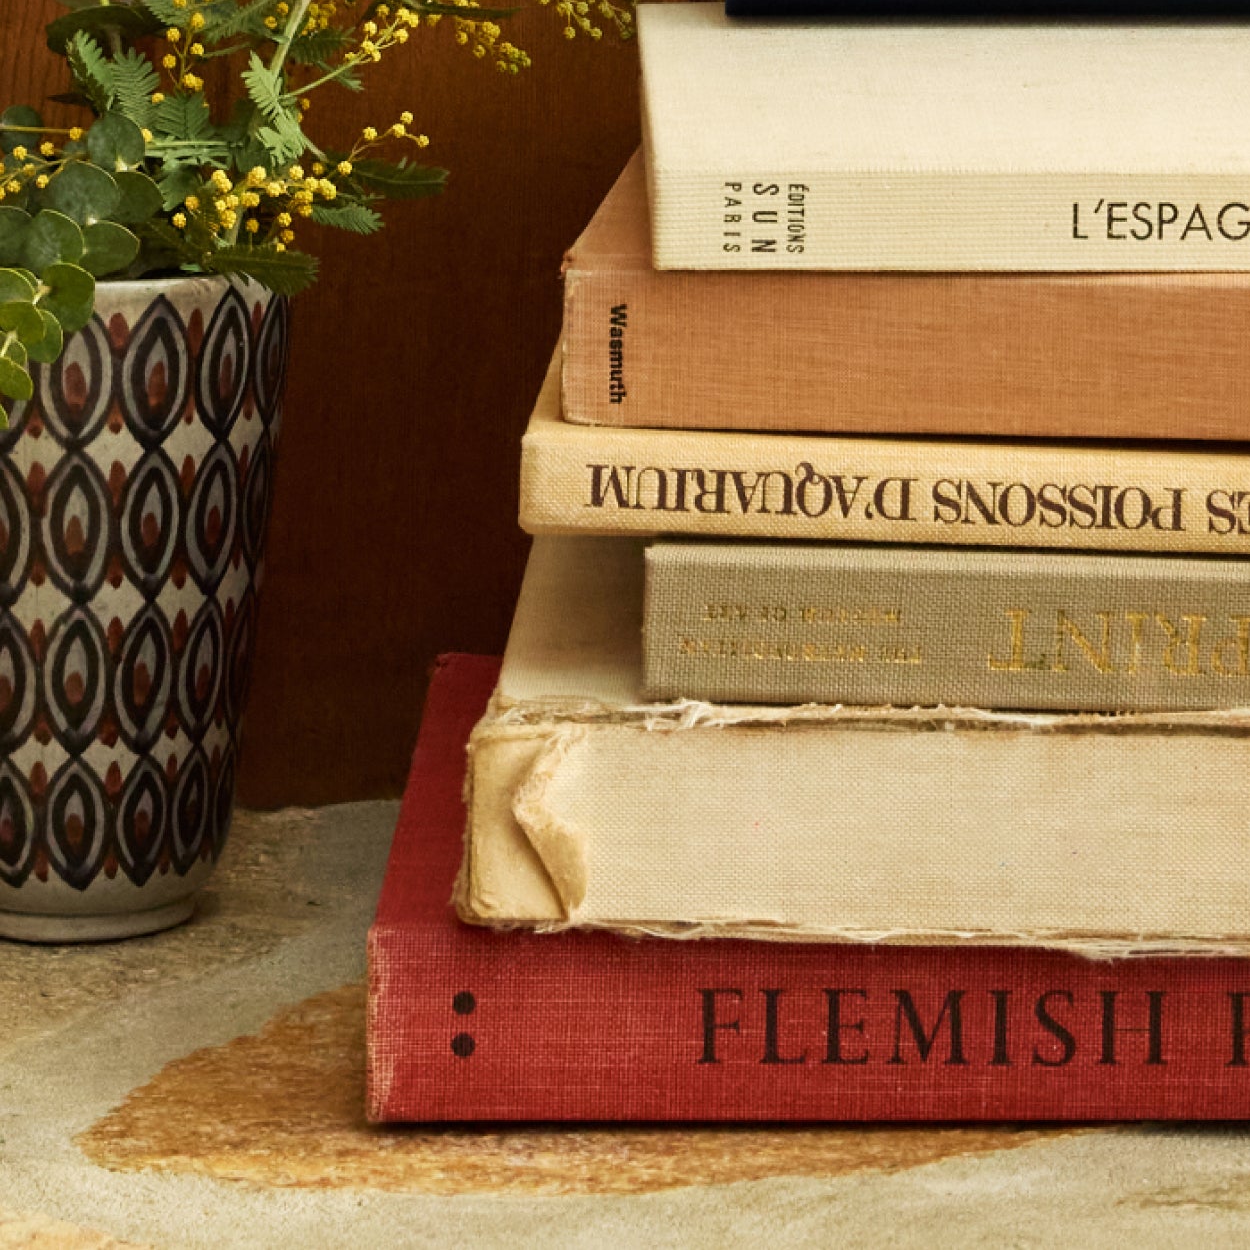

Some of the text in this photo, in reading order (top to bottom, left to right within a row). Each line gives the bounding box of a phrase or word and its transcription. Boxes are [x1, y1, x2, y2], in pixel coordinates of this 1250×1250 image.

[723, 182, 742, 253] PARIS
[751, 183, 779, 253] SUN
[786, 183, 810, 254] ÉDITIONS
[609, 303, 627, 404] Wasmuth
[933, 476, 1187, 531] POISSONS
[696, 987, 1168, 1068] FLEMISH
